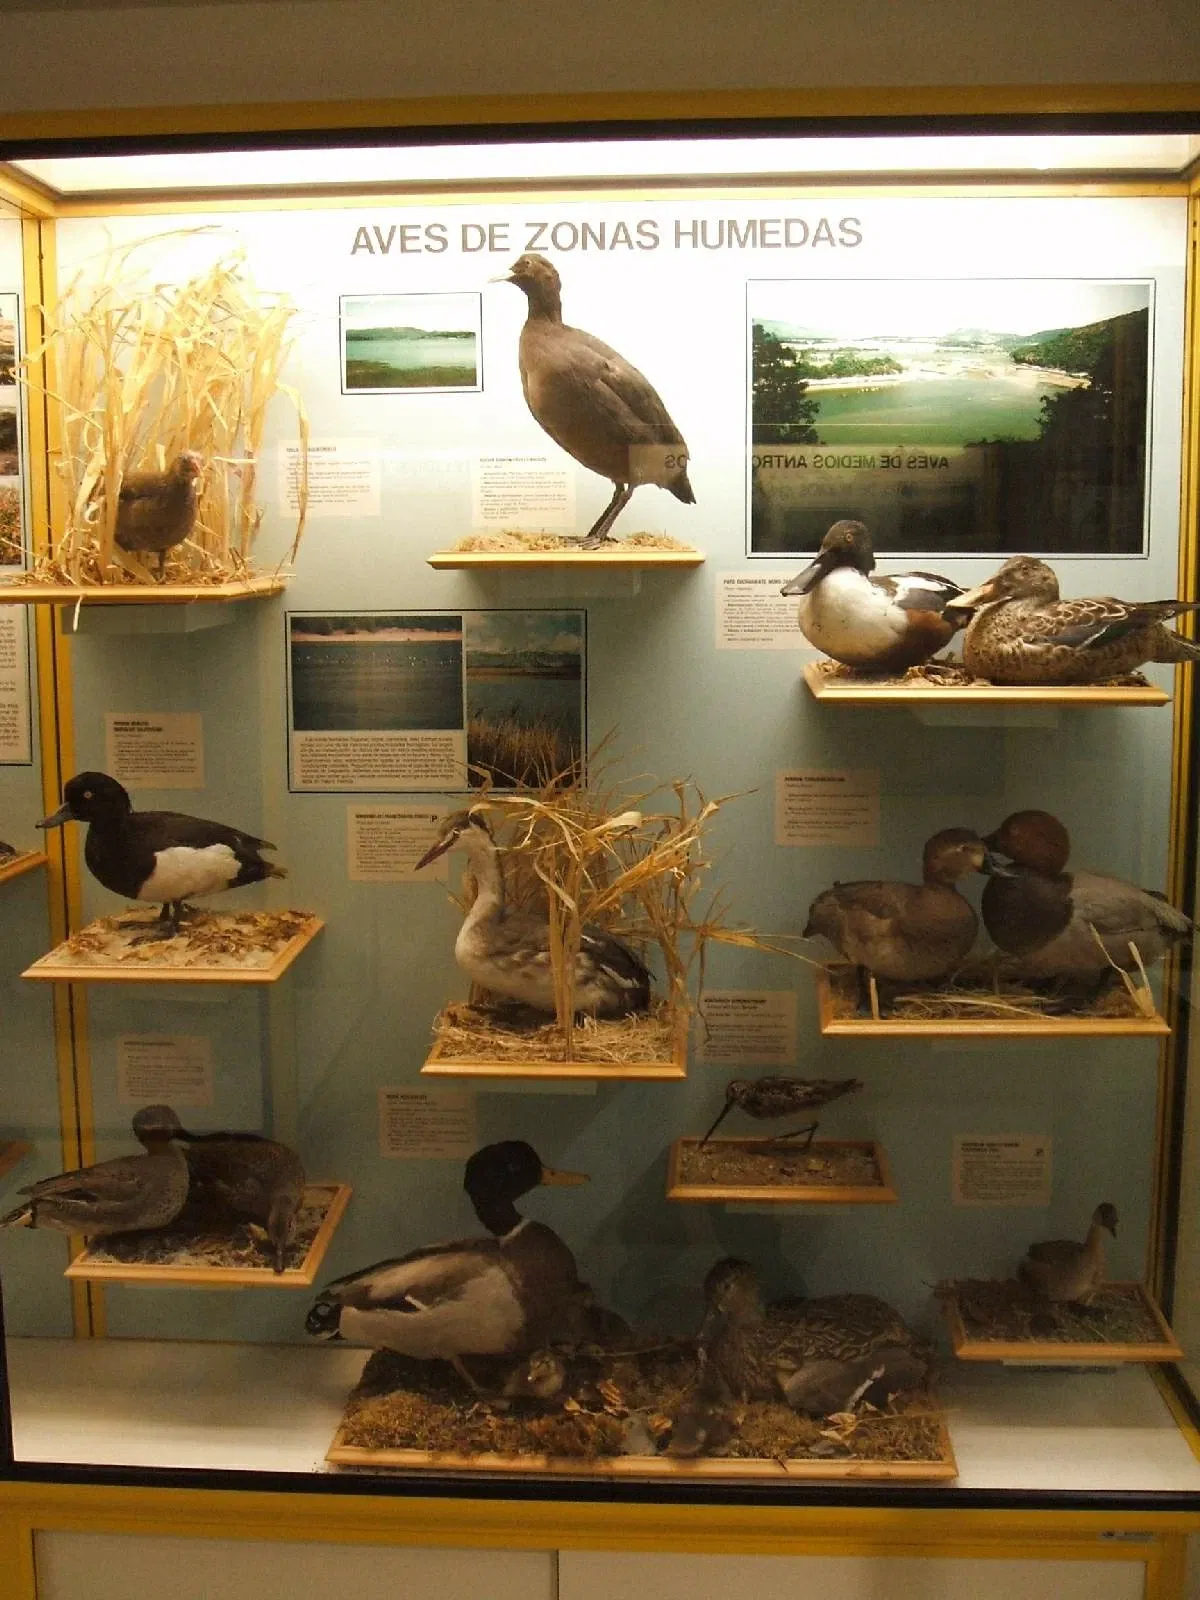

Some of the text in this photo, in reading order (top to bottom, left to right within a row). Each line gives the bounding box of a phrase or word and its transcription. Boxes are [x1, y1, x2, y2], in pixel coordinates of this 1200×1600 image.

[351, 217, 863, 253] AVES DE ZONAS HUMEDAS
